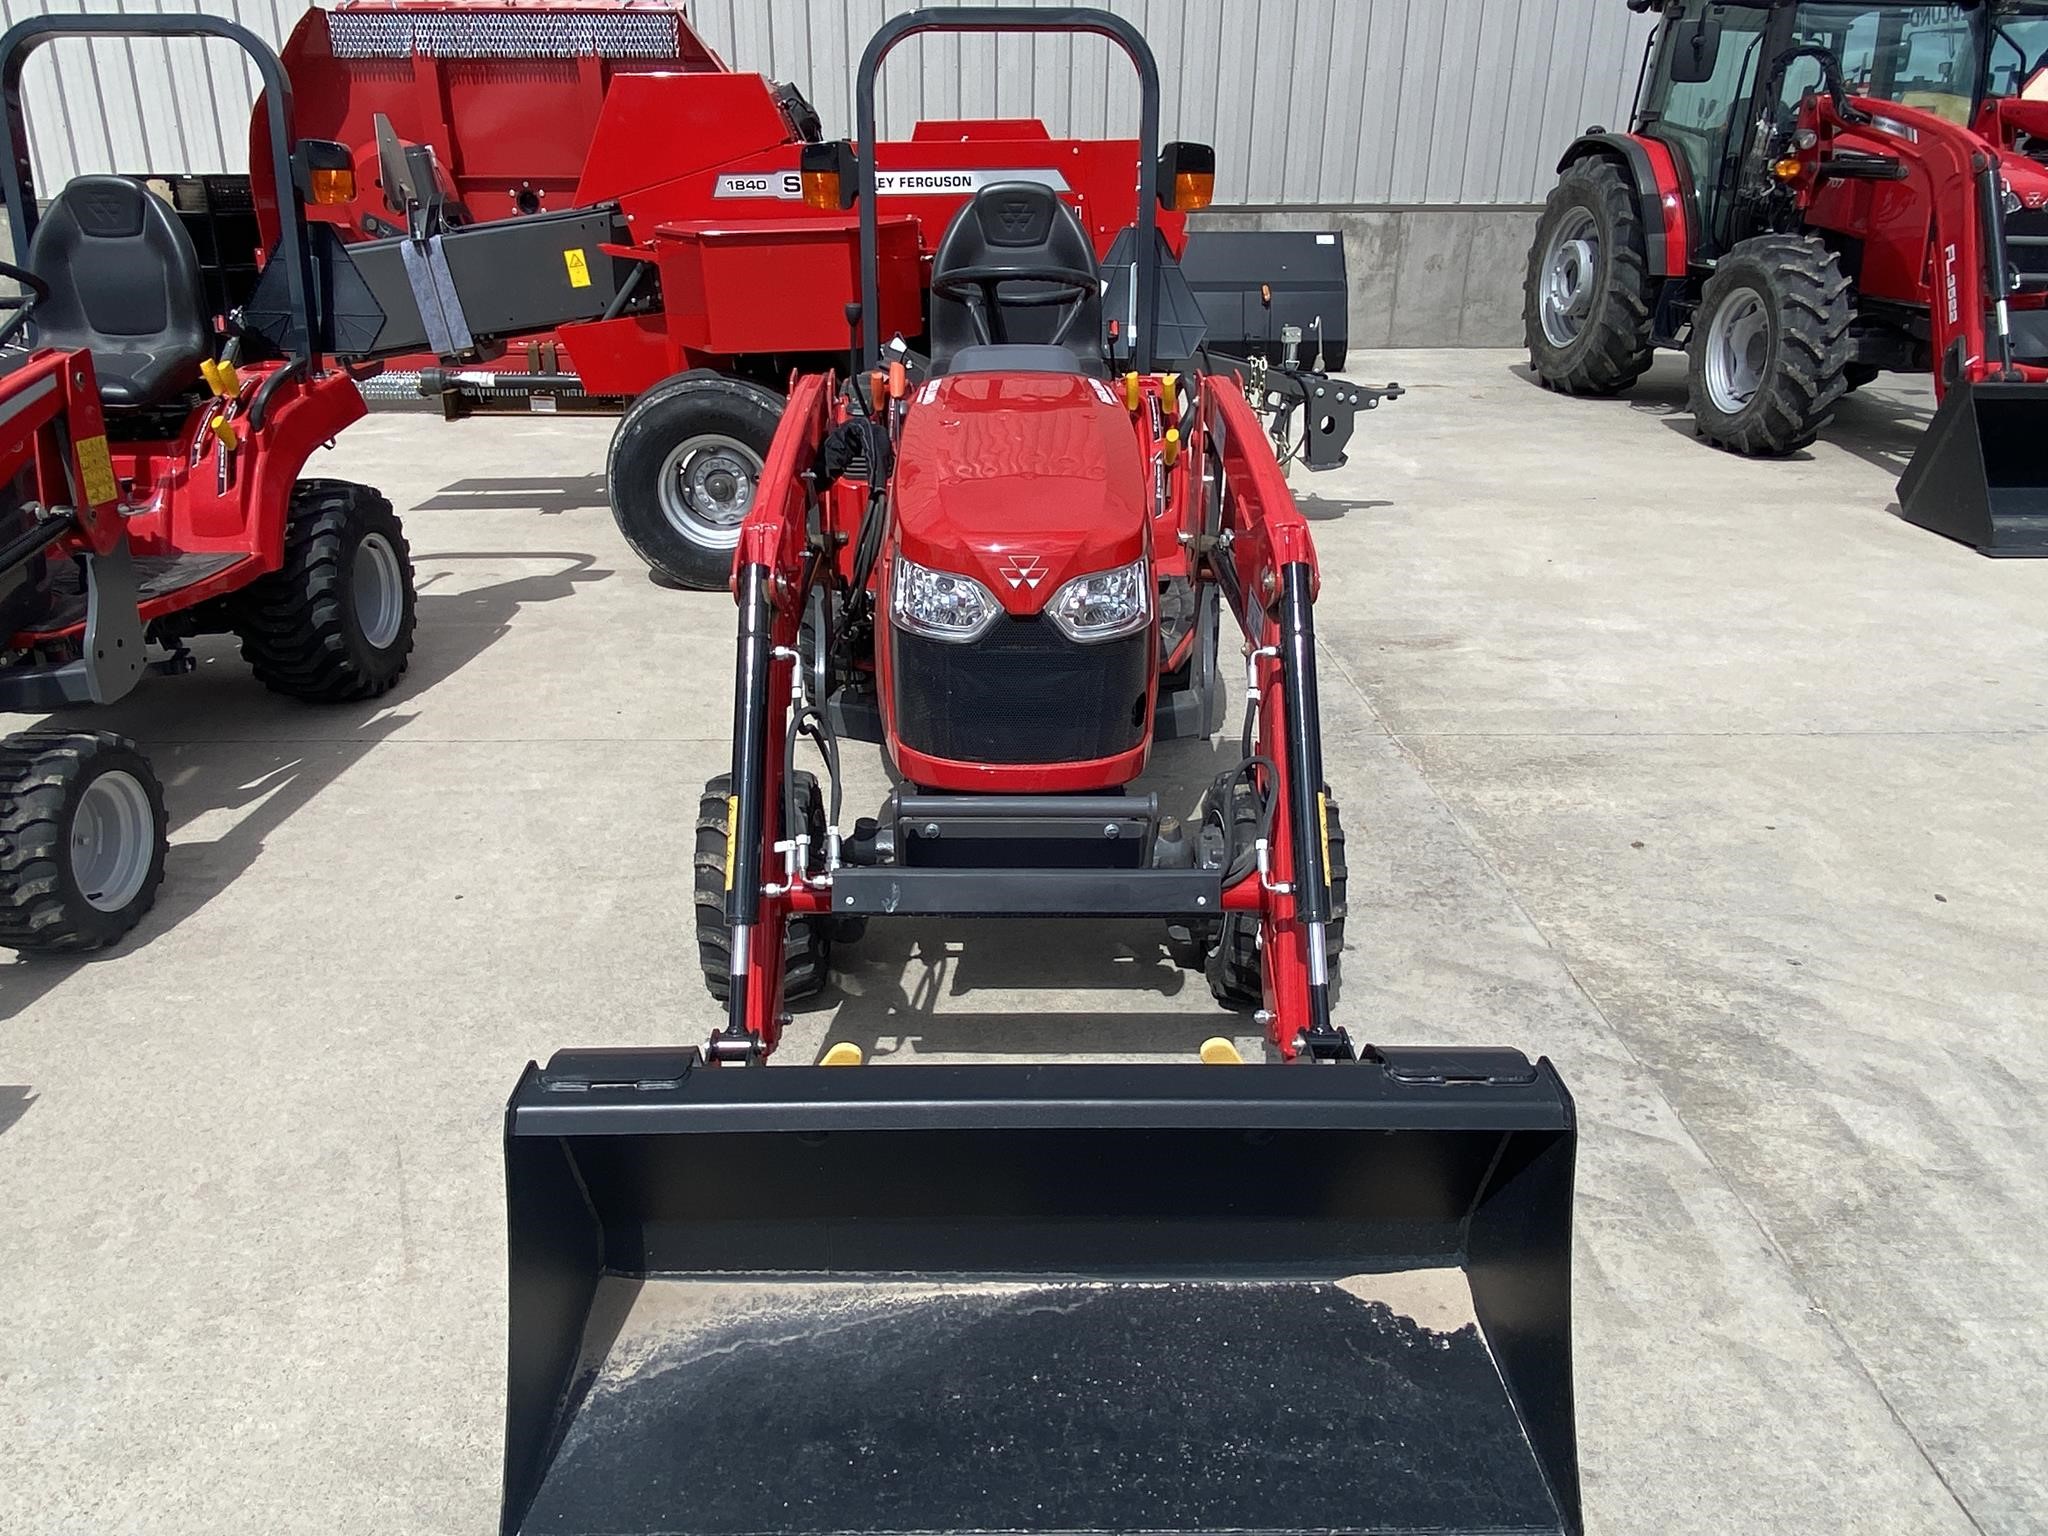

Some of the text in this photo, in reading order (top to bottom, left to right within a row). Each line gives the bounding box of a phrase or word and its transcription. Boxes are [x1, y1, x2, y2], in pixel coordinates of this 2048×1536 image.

[726, 180, 767, 191] 1840
[876, 177, 895, 190] EY
[899, 175, 972, 188] FERGUSON
[1826, 176, 1845, 189] 707
